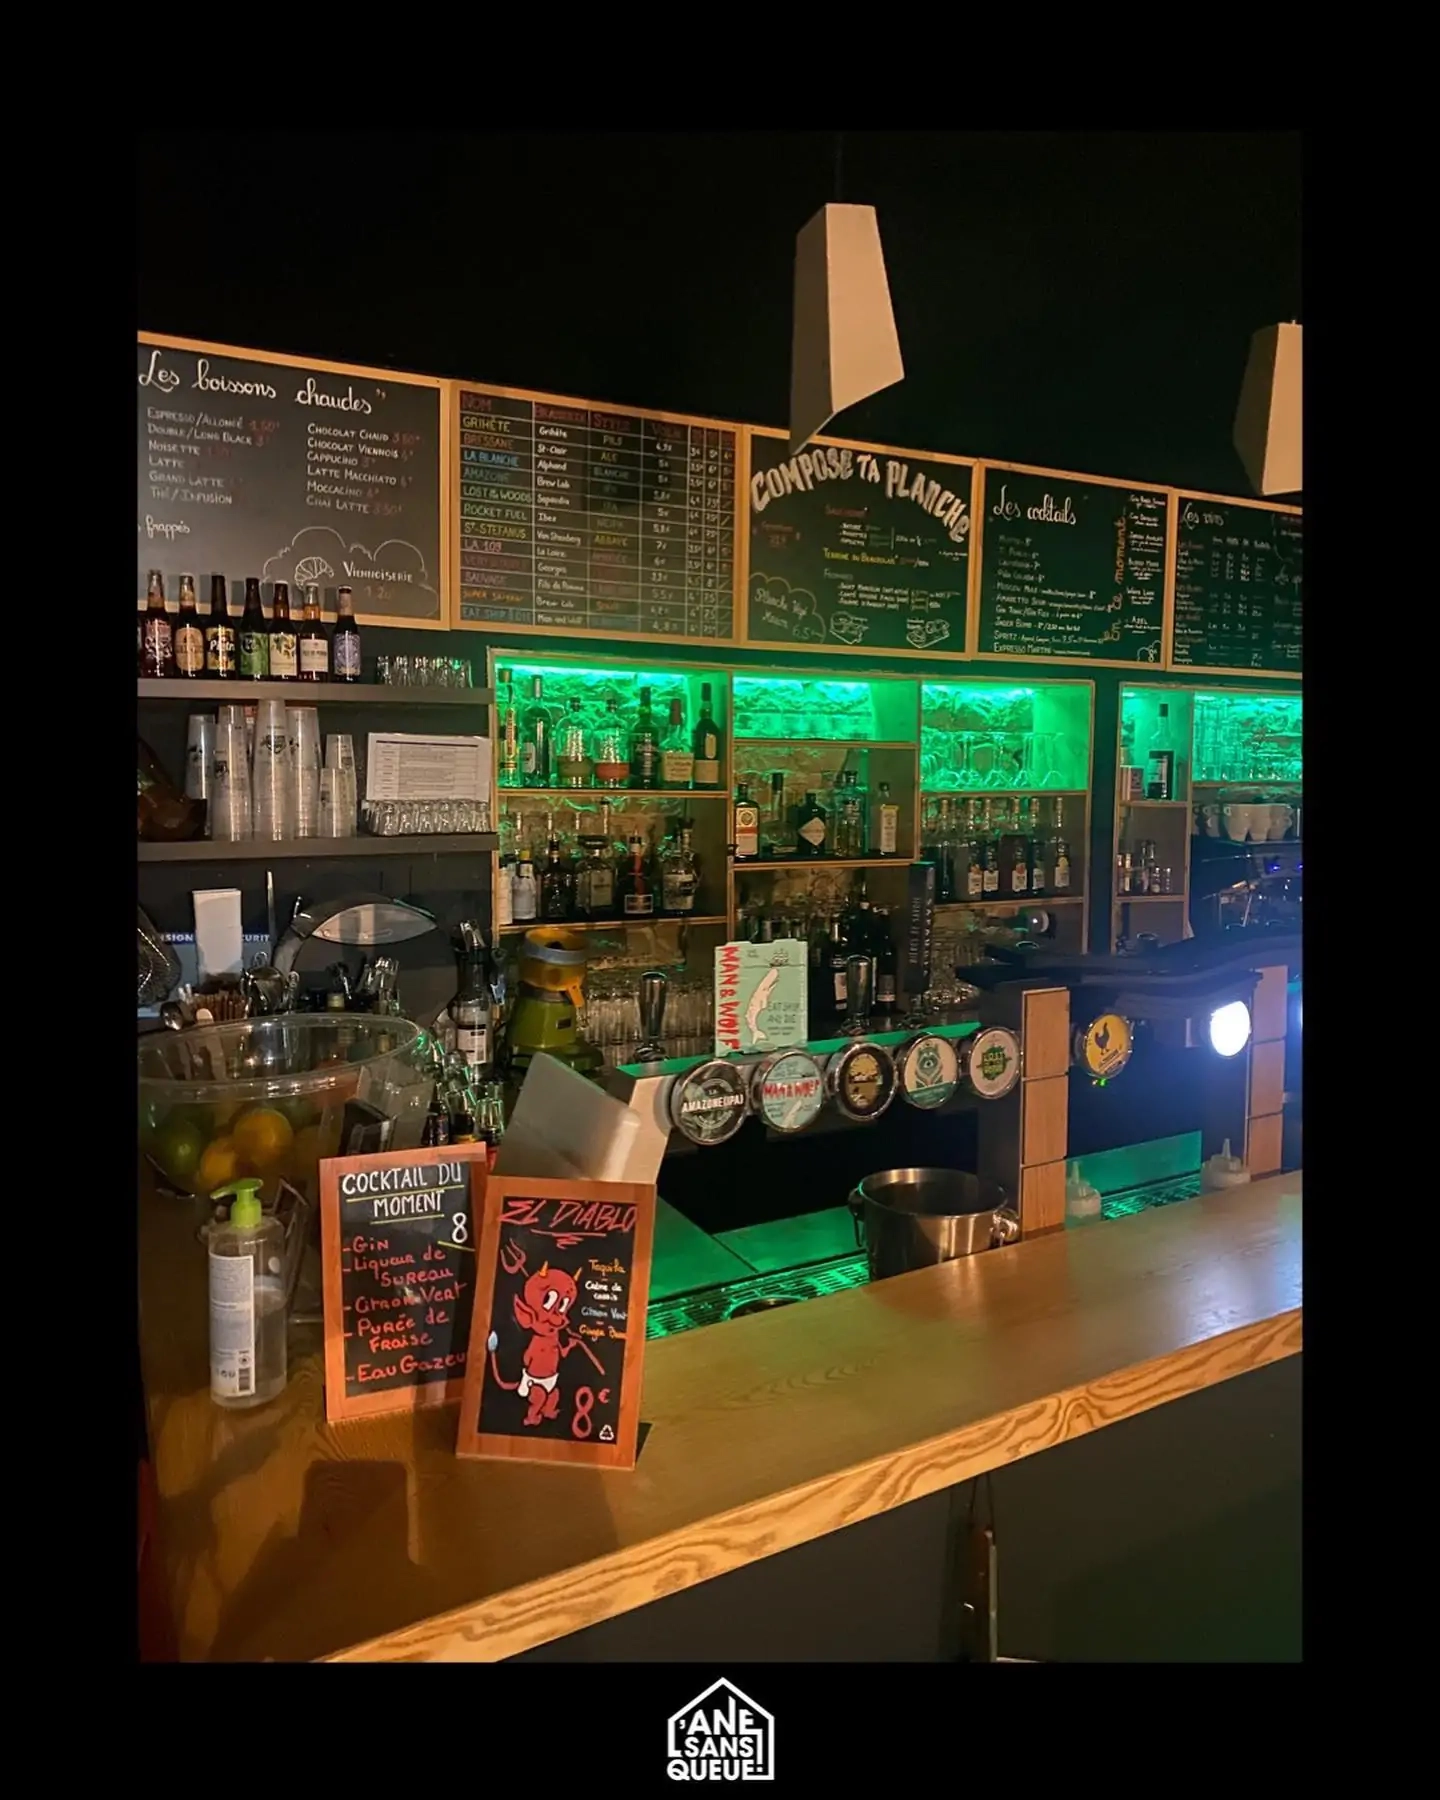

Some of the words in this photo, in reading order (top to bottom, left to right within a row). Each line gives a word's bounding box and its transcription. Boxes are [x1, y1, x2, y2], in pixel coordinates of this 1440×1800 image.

[139, 350, 180, 393] Les
[191, 358, 277, 398] boissons
[307, 422, 356, 439] CHOCOLAT
[359, 429, 390, 442] CHAUD
[462, 416, 511, 433] GRIHÈTE
[148, 440, 201, 456] NOISETTE
[222, 432, 253, 446] BLACK
[307, 436, 354, 453] CHOCOLAT
[358, 443, 399, 459] VIENNOIS
[148, 454, 186, 469] LATTE
[306, 450, 358, 466] CAPPUCINO
[463, 450, 477, 462] LA
[479, 451, 520, 467] BLANCHE
[148, 470, 186, 484] GRAND
[188, 473, 225, 488] LATTE
[307, 464, 340, 479] LATTE
[344, 468, 397, 486] MACCHIATO
[463, 486, 488, 499] LOST
[751, 448, 854, 513] COMPOSE
[857, 454, 881, 484] TA
[885, 459, 970, 544] PLANCHE
[306, 494, 331, 509] CHAI
[336, 498, 369, 514] LATTE
[463, 502, 502, 516] ROCKET
[505, 508, 528, 521] FUEL
[993, 484, 1021, 521] Les
[1027, 493, 1077, 526] cocktails
[145, 514, 191, 541] frappés
[464, 539, 479, 550] LA
[342, 561, 413, 584] VIENNOISERIE
[463, 607, 481, 618] EAT
[719, 945, 741, 985] MAN
[720, 988, 737, 998] &
[717, 1000, 742, 1050] WOLF
[342, 1166, 428, 1194] COCKTAIL
[438, 1161, 462, 1187] DU
[374, 1190, 444, 1218] MOMENT
[549, 1200, 637, 1233] DIABLO
[451, 1212, 468, 1244] 8
[354, 1252, 415, 1280] Liqueur
[422, 1246, 446, 1262] de
[588, 1258, 626, 1277] Tequila
[380, 1269, 454, 1288] Sureau
[611, 1282, 622, 1292] de
[354, 1296, 421, 1315] Citron
[420, 1282, 468, 1302] Vert
[358, 1313, 416, 1337] Purée
[425, 1308, 449, 1325] de
[369, 1332, 433, 1354] Fraise
[358, 1363, 397, 1383] Eau
